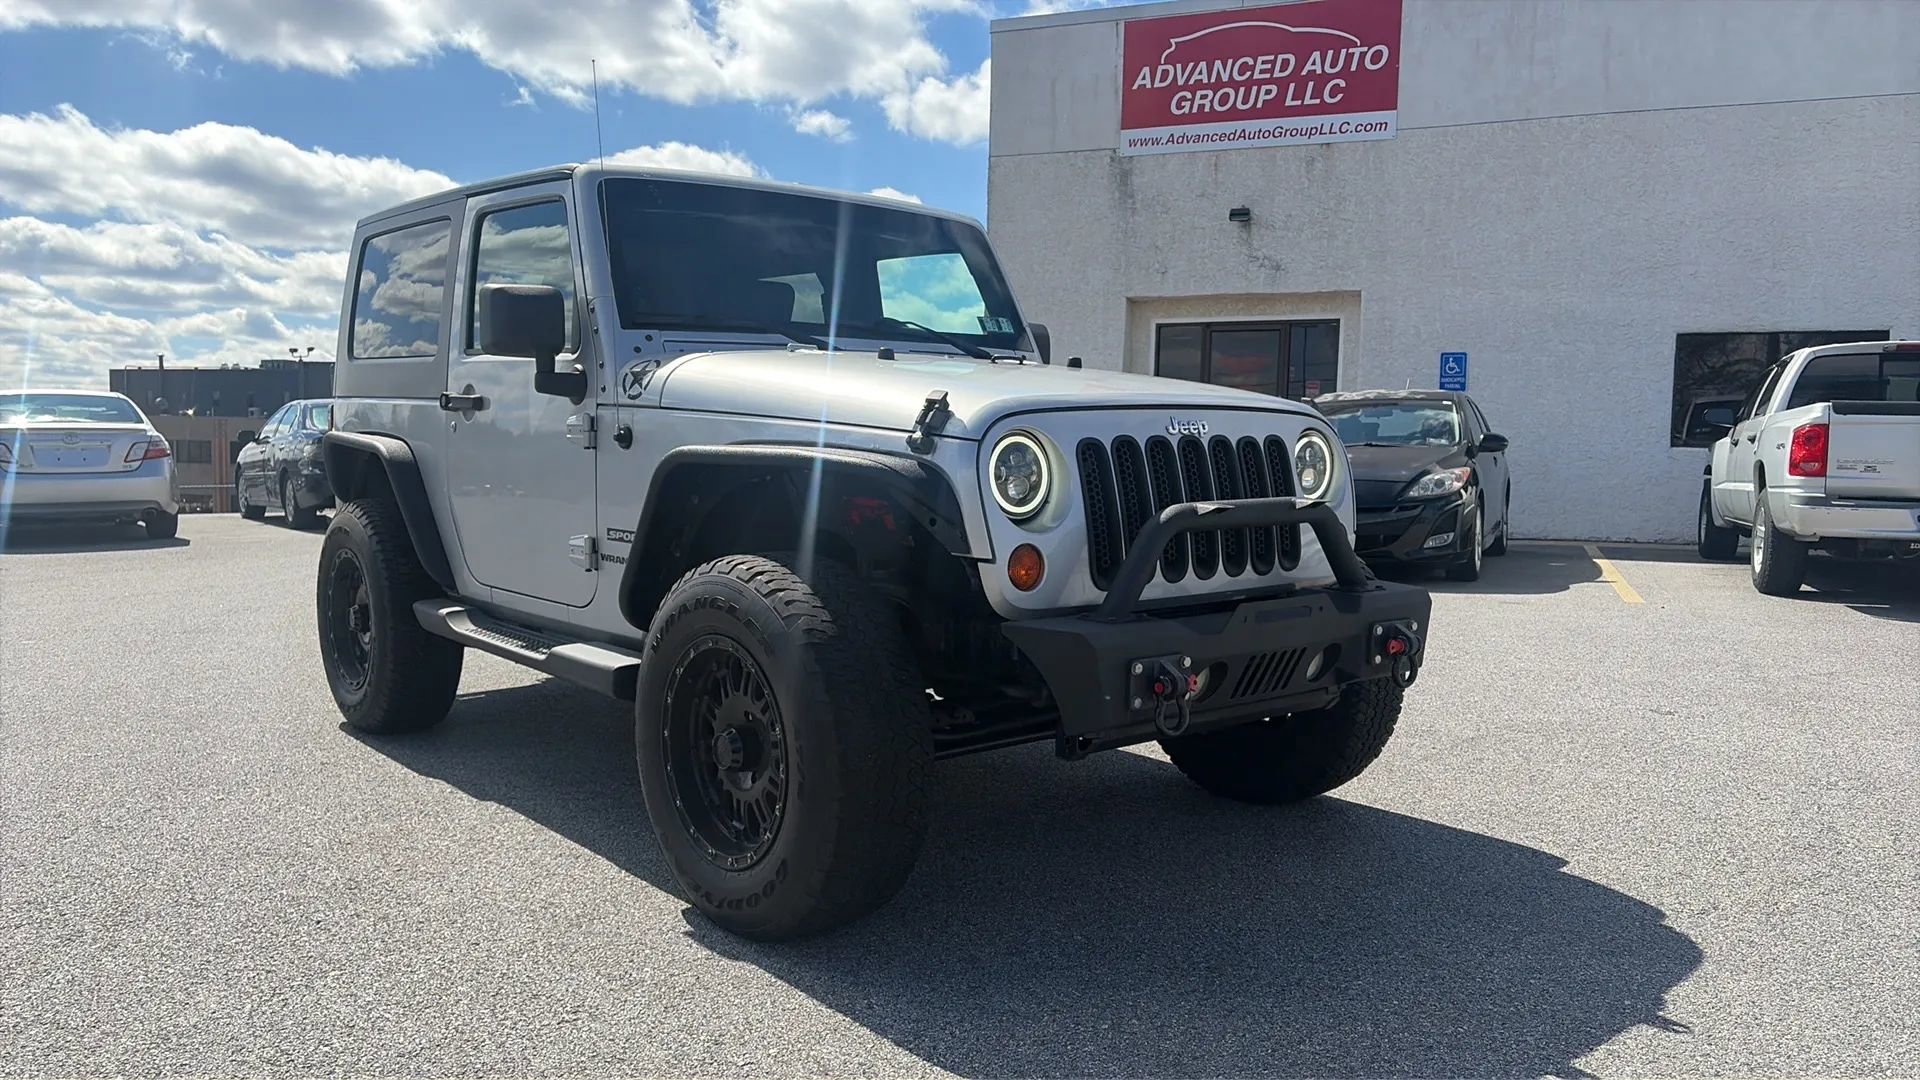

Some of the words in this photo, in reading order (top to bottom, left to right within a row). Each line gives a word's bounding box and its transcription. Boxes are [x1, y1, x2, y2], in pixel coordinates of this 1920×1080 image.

[1132, 57, 1295, 89] ADVANCED
[1301, 44, 1389, 75] AUTO
[1170, 86, 1277, 115] GROUP
[1284, 79, 1345, 106] LLC
[1128, 121, 1388, 148] www.AdvancedAutoGroupLLC.com
[1166, 416, 1208, 438] Jeep
